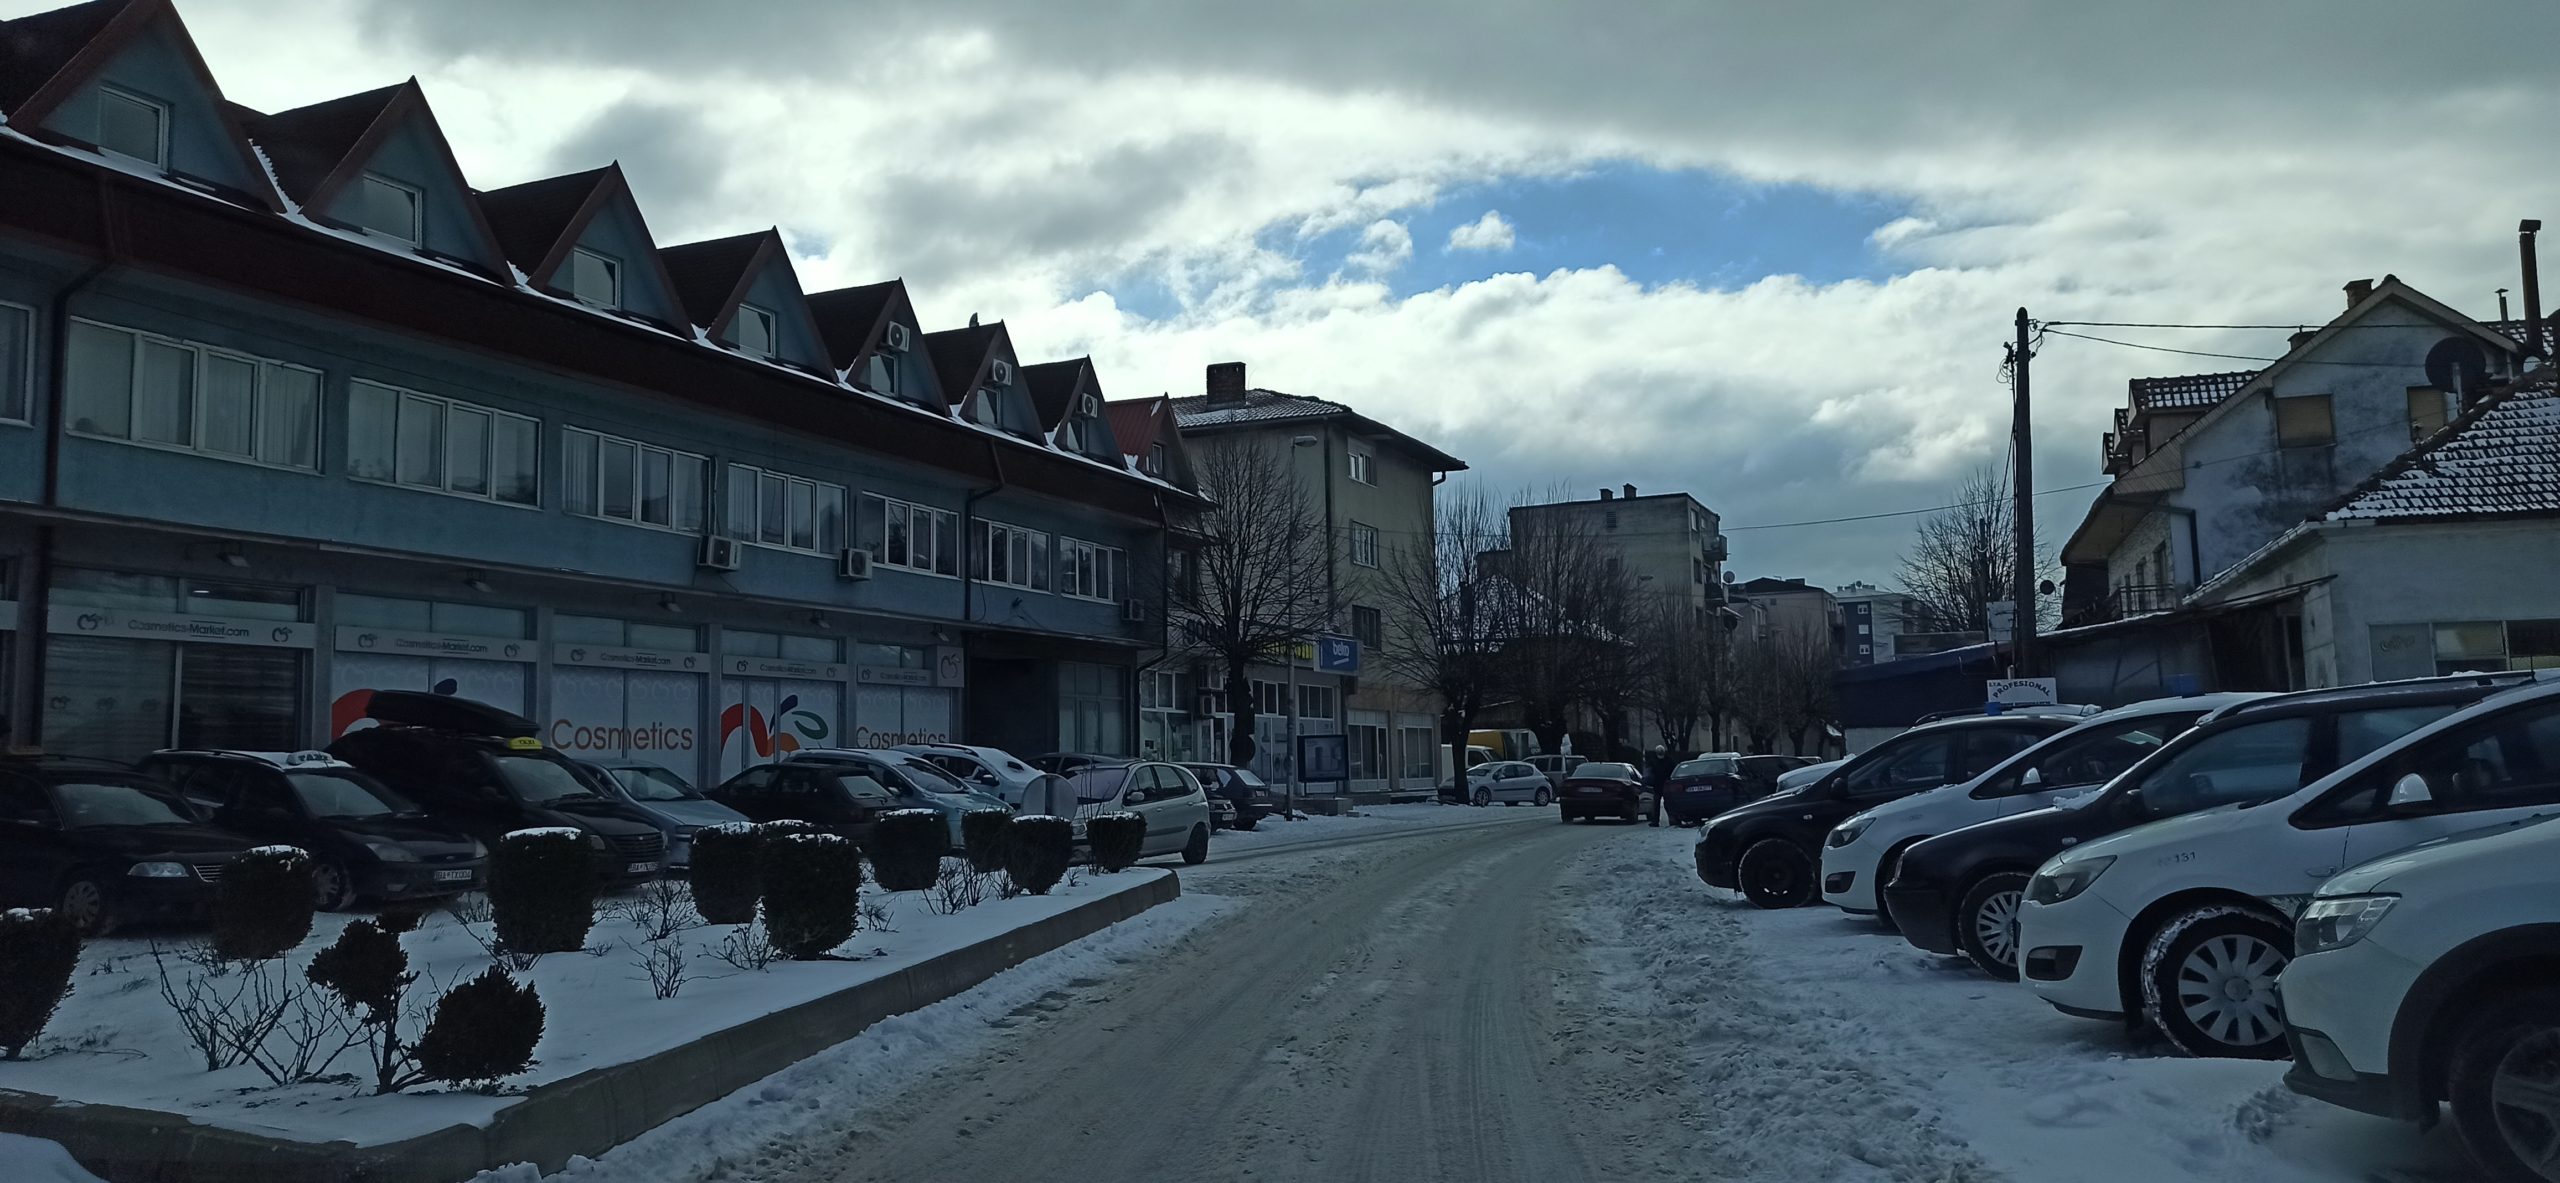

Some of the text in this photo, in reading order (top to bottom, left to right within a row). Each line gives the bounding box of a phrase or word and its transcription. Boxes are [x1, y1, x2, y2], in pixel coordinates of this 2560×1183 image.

[128, 619, 249, 638] Cosmetics-Market.com
[1992, 681, 2051, 698] PROFESIONAL
[551, 718, 693, 750] Cosmetics
